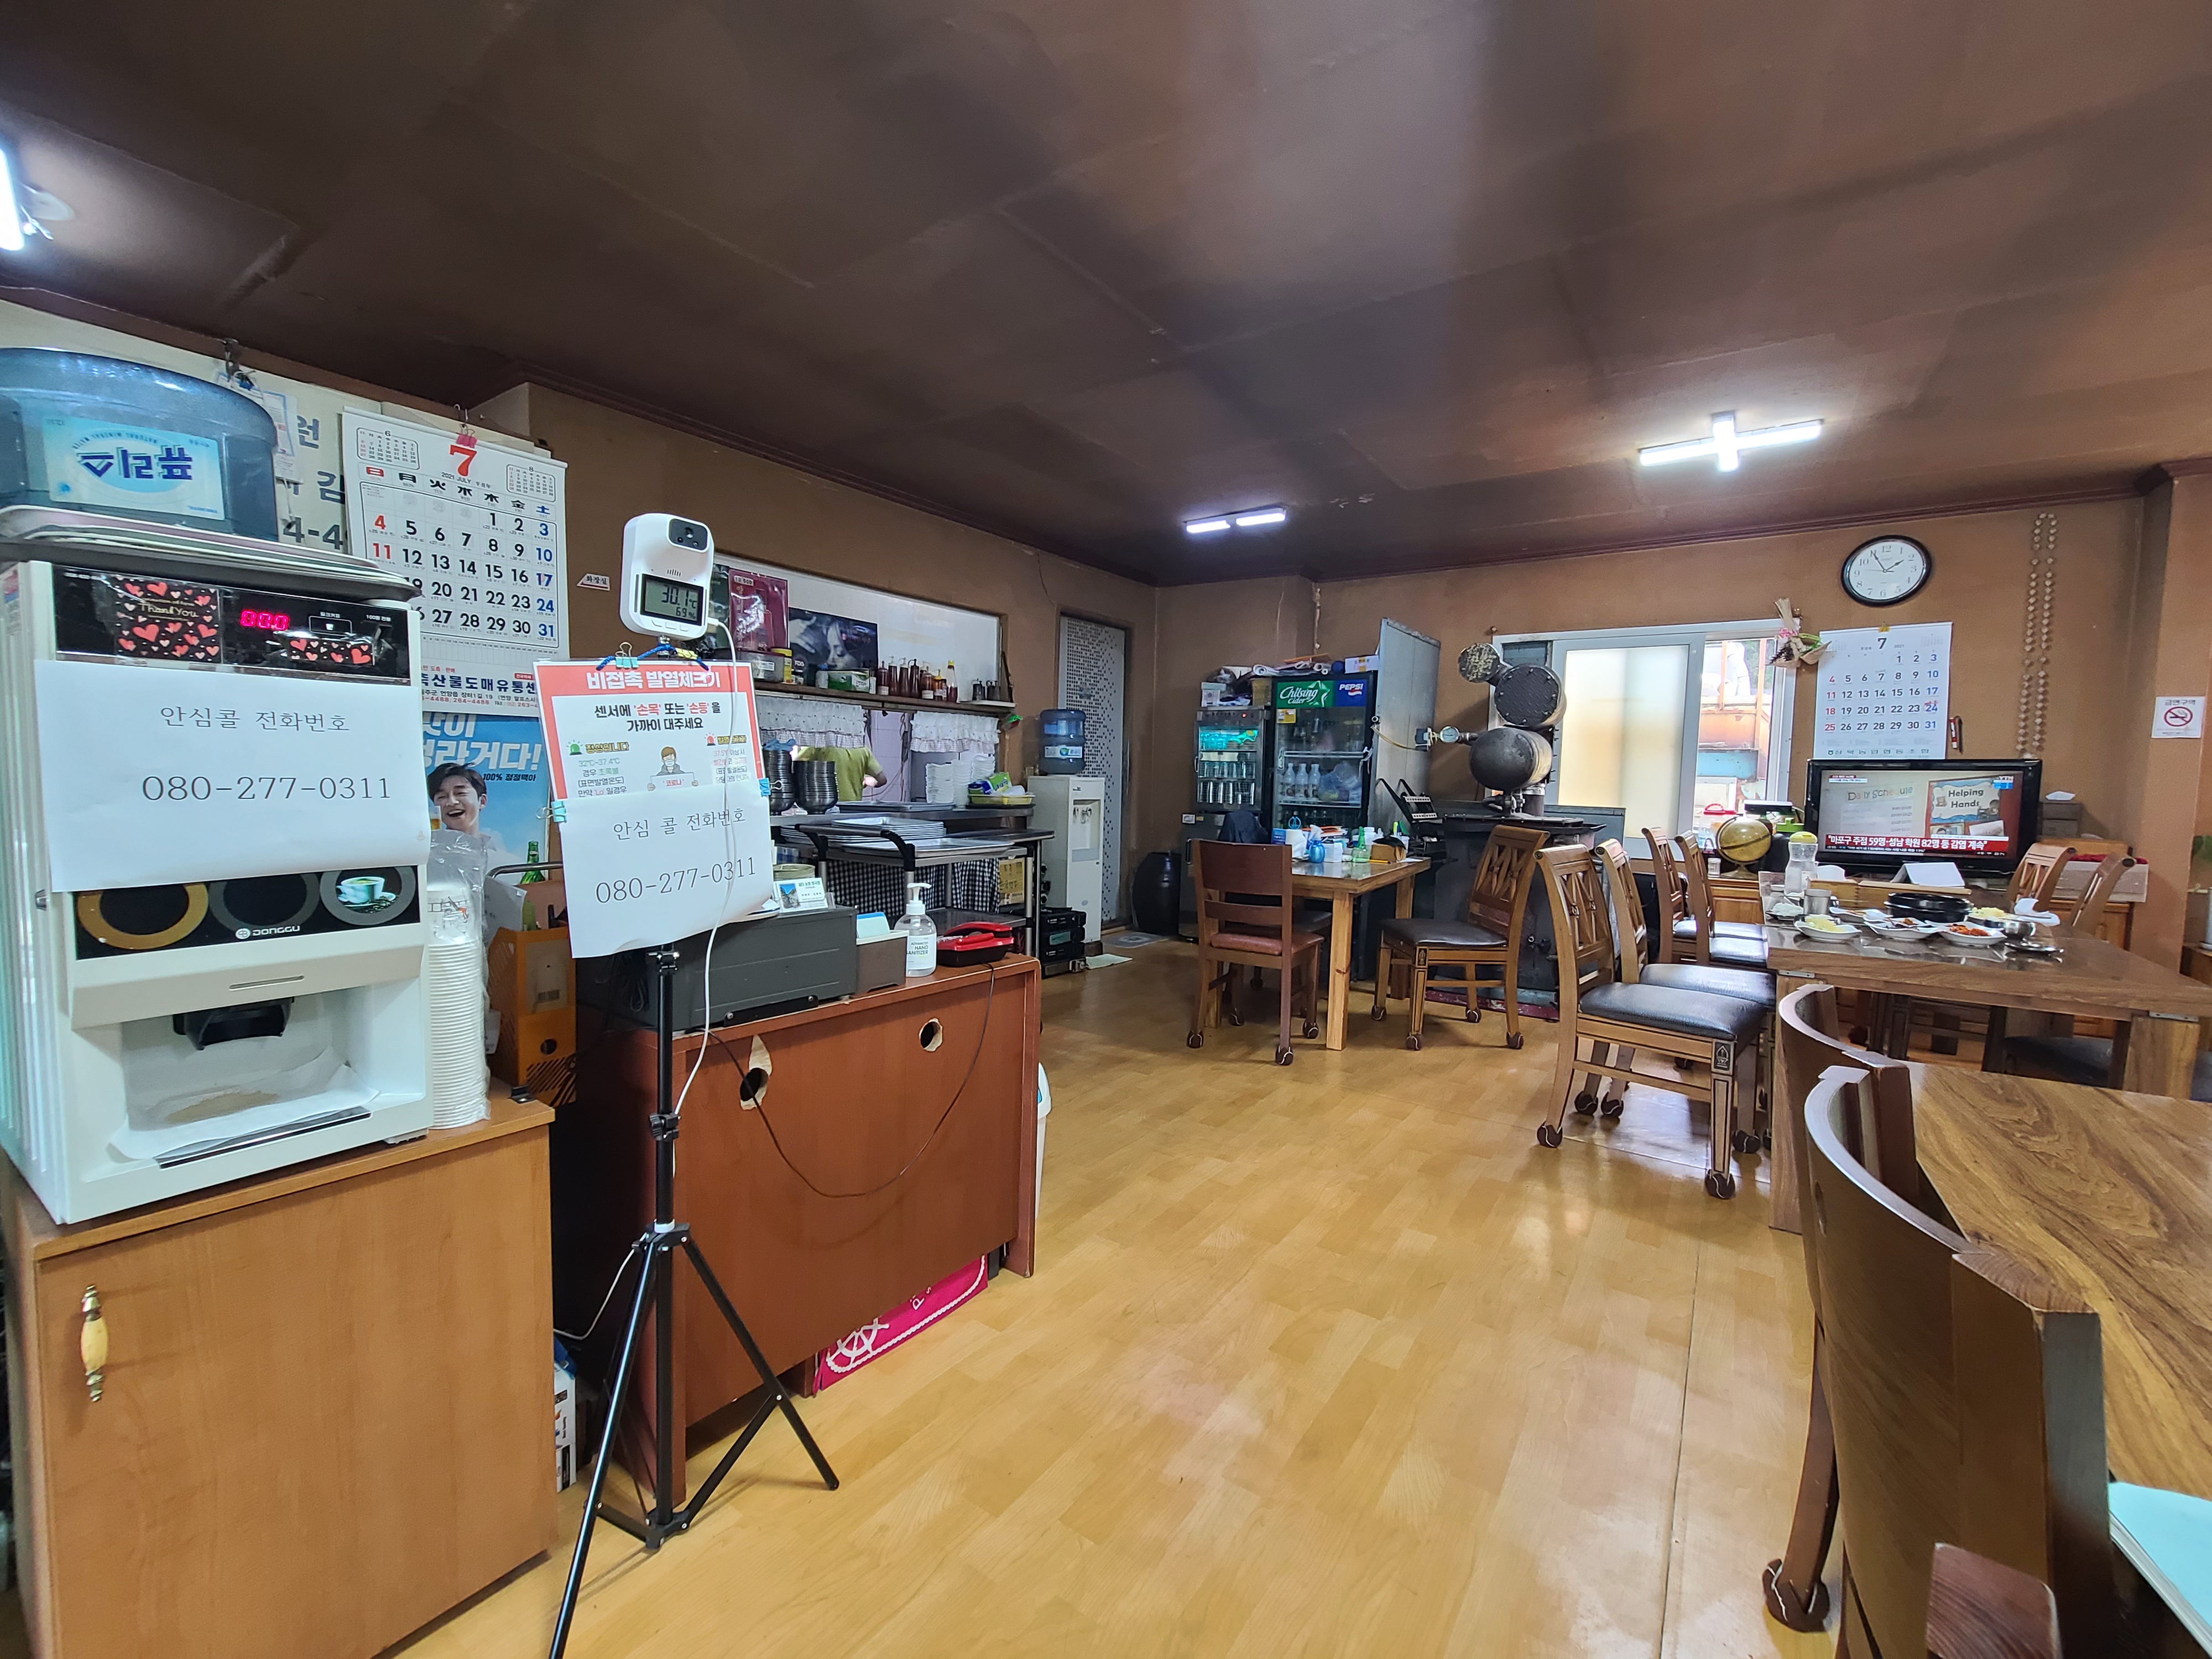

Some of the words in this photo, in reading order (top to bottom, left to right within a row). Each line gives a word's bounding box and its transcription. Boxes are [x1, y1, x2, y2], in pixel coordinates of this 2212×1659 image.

[77, 445, 192, 480] 퓨리스
[450, 445, 477, 476] 7
[366, 467, 384, 477] 日
[399, 473, 416, 483] 月
[430, 479, 446, 491] 火
[457, 486, 472, 496] 水
[484, 493, 499, 503] 木
[511, 500, 525, 509] 金
[536, 505, 550, 514] 土
[490, 513, 495, 525] 1
[515, 518, 524, 531] 2
[540, 523, 549, 536] 3
[374, 515, 386, 530] 4
[406, 520, 417, 535] 5
[435, 528, 445, 541] 6
[462, 533, 472, 546] 7
[489, 539, 498, 551] 8
[515, 544, 524, 556] 9
[536, 547, 552, 562] 10
[431, 582, 452, 597] 20
[461, 586, 477, 602] 21
[486, 591, 505, 606] 22
[511, 594, 530, 609] 23
[536, 598, 554, 612] 24
[174, 607, 199, 617] You
[432, 609, 452, 624] 27
[460, 613, 479, 628] 28
[487, 617, 505, 630] 29
[513, 620, 530, 634] 30
[538, 623, 553, 637] 31
[1877, 638, 1887, 649] 7
[586, 671, 643, 690] 비접촉
[646, 671, 721, 688] 발열체크기
[160, 705, 240, 730] 안심콜
[255, 709, 351, 733] 전화번호
[594, 705, 631, 718] 센서에
[634, 703, 661, 716] '손목'
[665, 703, 685, 714] 또는
[686, 702, 709, 714] '손등'
[712, 702, 721, 713] 을
[627, 719, 661, 732] 가까이
[664, 717, 703, 730] 대주세요
[585, 742, 629, 754] 정상입니다
[142, 775, 391, 801] 080-277-0311
[1948, 789, 1984, 797] Helping
[613, 819, 649, 841] 안심
[660, 817, 677, 834] 콜
[687, 807, 746, 831] 전화번호
[1853, 837, 1867, 846] 주점
[1905, 838, 1921, 848] 학원
[1921, 839, 1939, 848] 82명
[1941, 839, 1950, 849] 등
[1951, 840, 1966, 849] 감염
[596, 857, 757, 904] 080-277-0311
[253, 925, 300, 936] DONGGU
